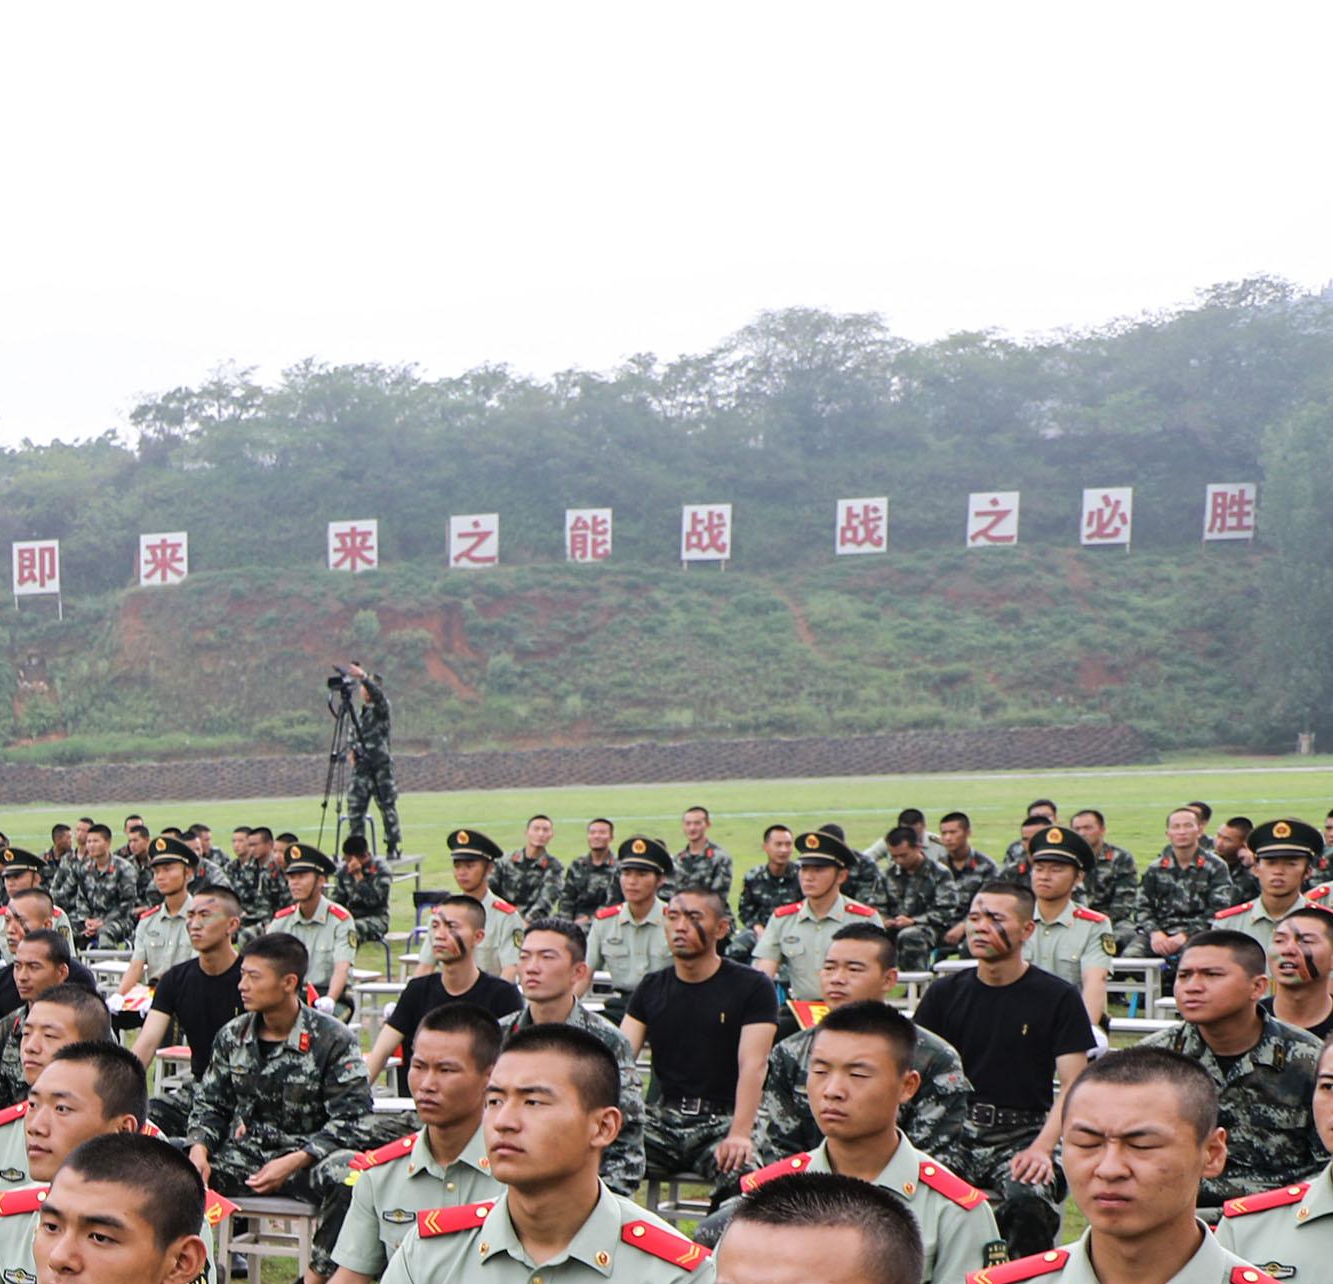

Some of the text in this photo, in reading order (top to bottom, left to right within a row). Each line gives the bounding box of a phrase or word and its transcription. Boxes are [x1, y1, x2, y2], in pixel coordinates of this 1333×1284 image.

[333, 510, 727, 571] 来 之 能 战
[839, 490, 1252, 548] 战 之 必 胜
[17, 546, 56, 586] 即
[143, 538, 184, 581] 来
